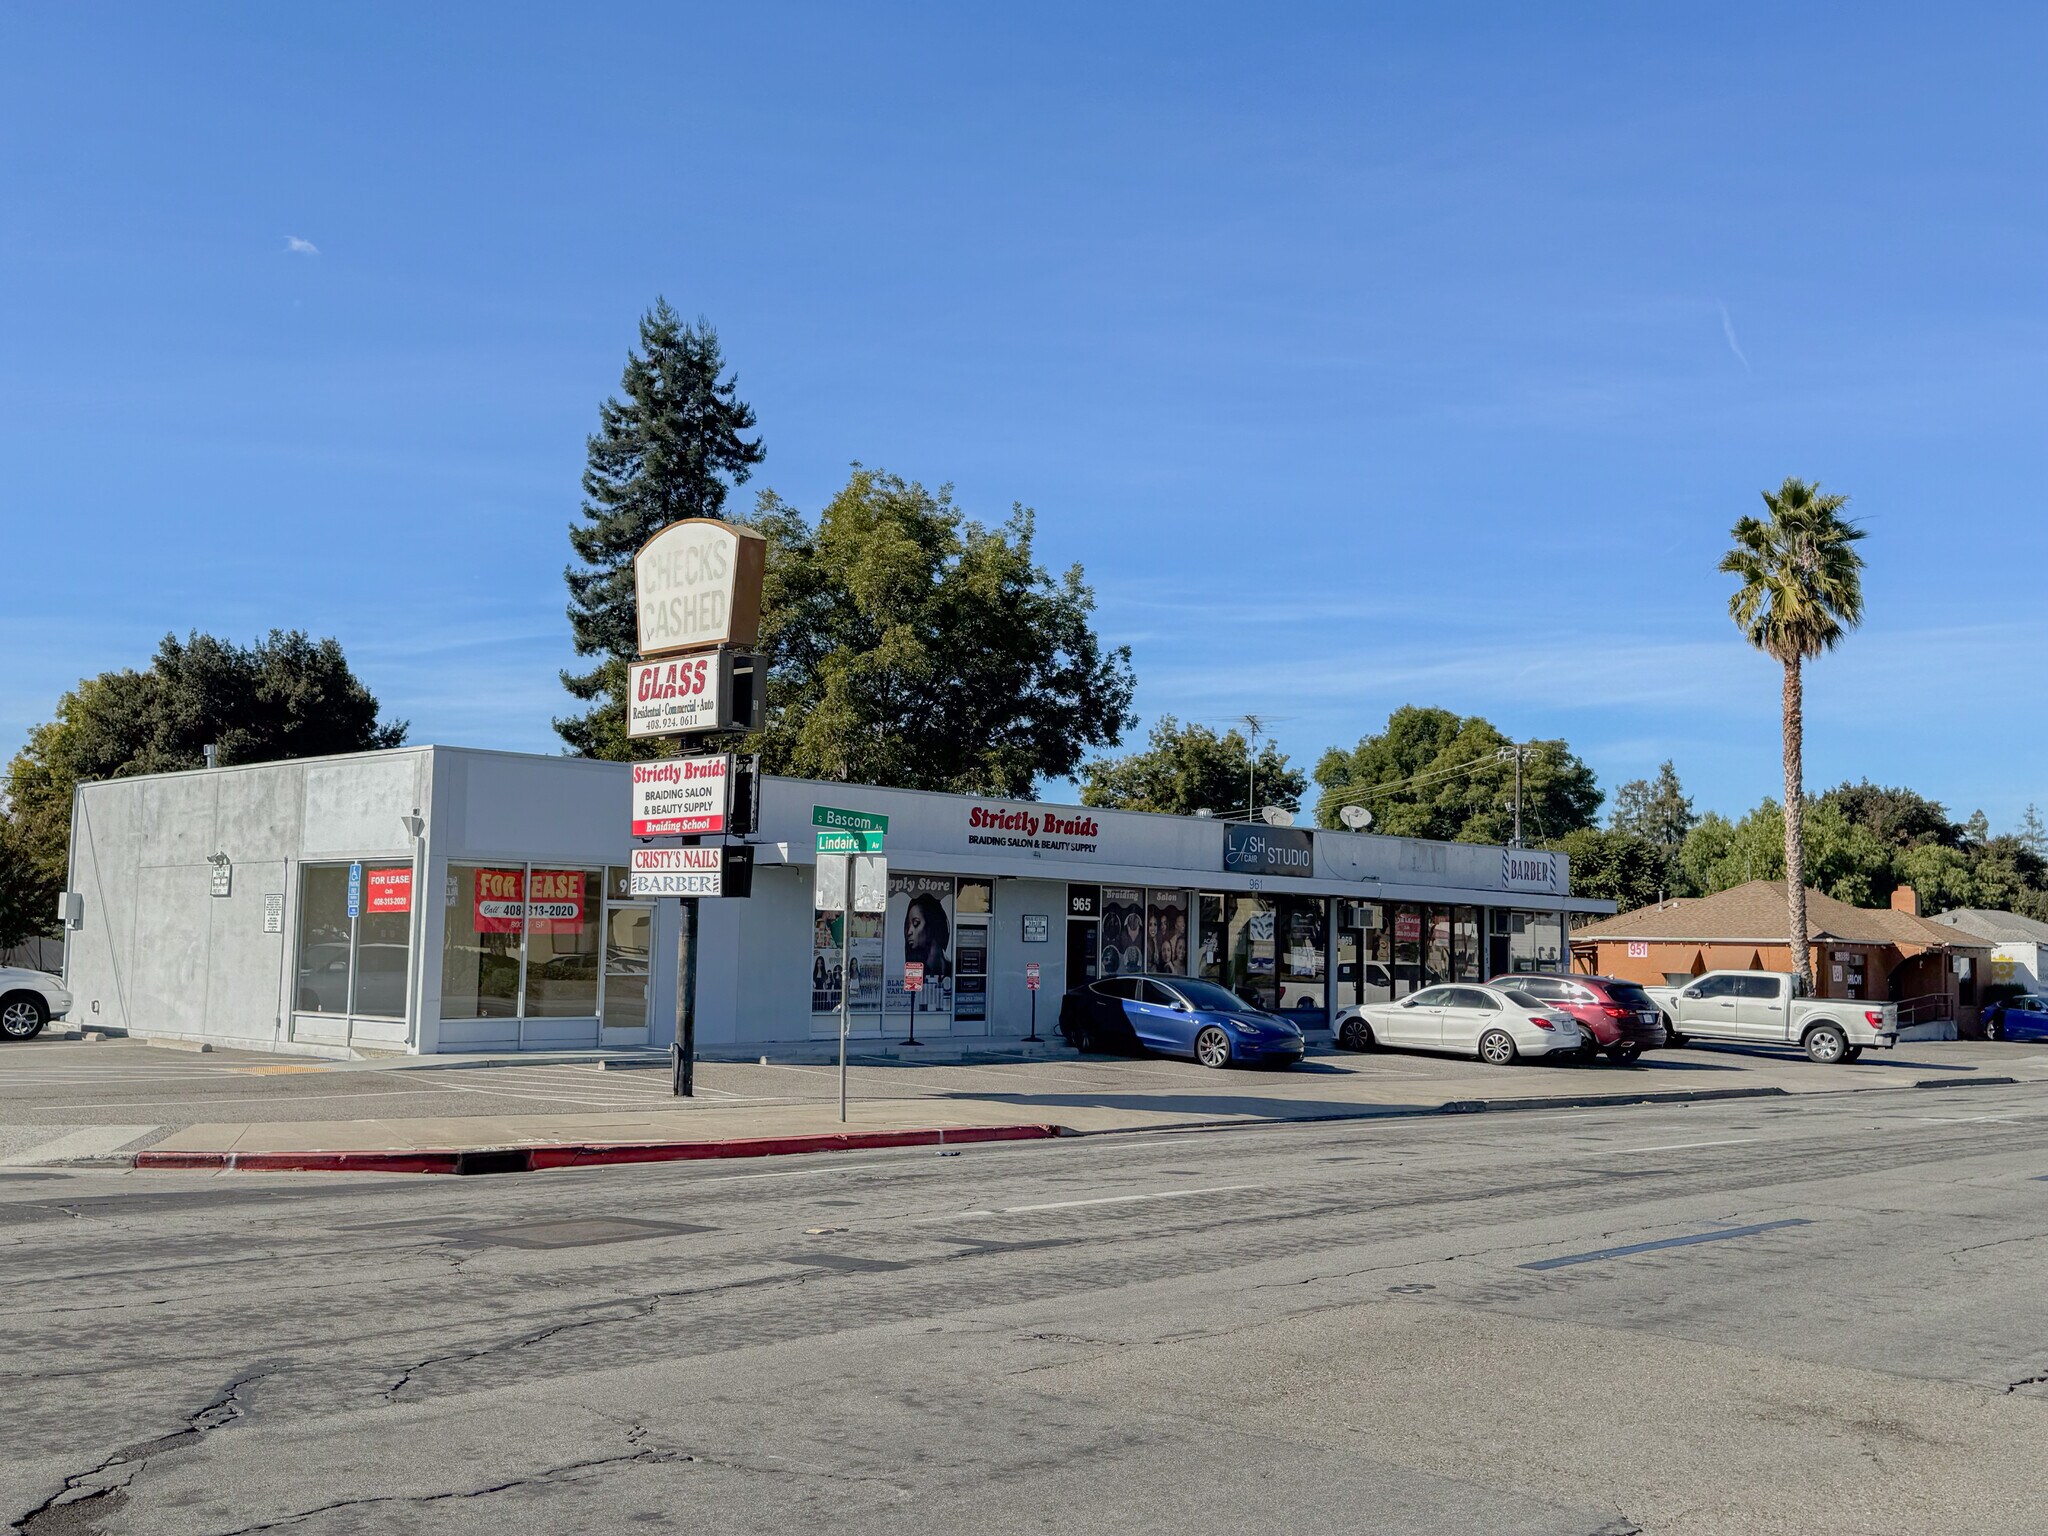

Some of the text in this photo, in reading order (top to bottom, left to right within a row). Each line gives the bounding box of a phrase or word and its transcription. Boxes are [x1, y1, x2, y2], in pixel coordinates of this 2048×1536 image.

[644, 539, 728, 594] CHECKS
[643, 589, 726, 641] CASHED
[638, 659, 708, 702] GLASS
[633, 698, 714, 720] Residential Commercial Auto
[633, 759, 726, 785] Strictly Braids
[645, 786, 712, 801] BRAIDING SALON
[644, 801, 713, 815] & BEAUTY SUPPLY
[646, 817, 710, 833] Braiding School
[818, 810, 883, 831] S Bascom Av
[969, 806, 1099, 837] Strictly Braids
[818, 836, 880, 850] Lindaire Av
[968, 834, 1097, 853] BRAIDING SALON & BEAUTY SUPPLY
[635, 849, 718, 869] CRISTY'S NAILS
[1267, 846, 1310, 867] STUDIO
[371, 875, 410, 885] FOR LEASE
[1510, 859, 1548, 882] BARBER
[480, 873, 515, 897] FOR
[637, 876, 712, 893] BARBER
[918, 877, 950, 891] Store
[1249, 878, 1263, 890] 961
[1072, 897, 1091, 911] 965
[1106, 890, 1177, 902] Braiding Salon
[1630, 943, 1646, 956] 951
